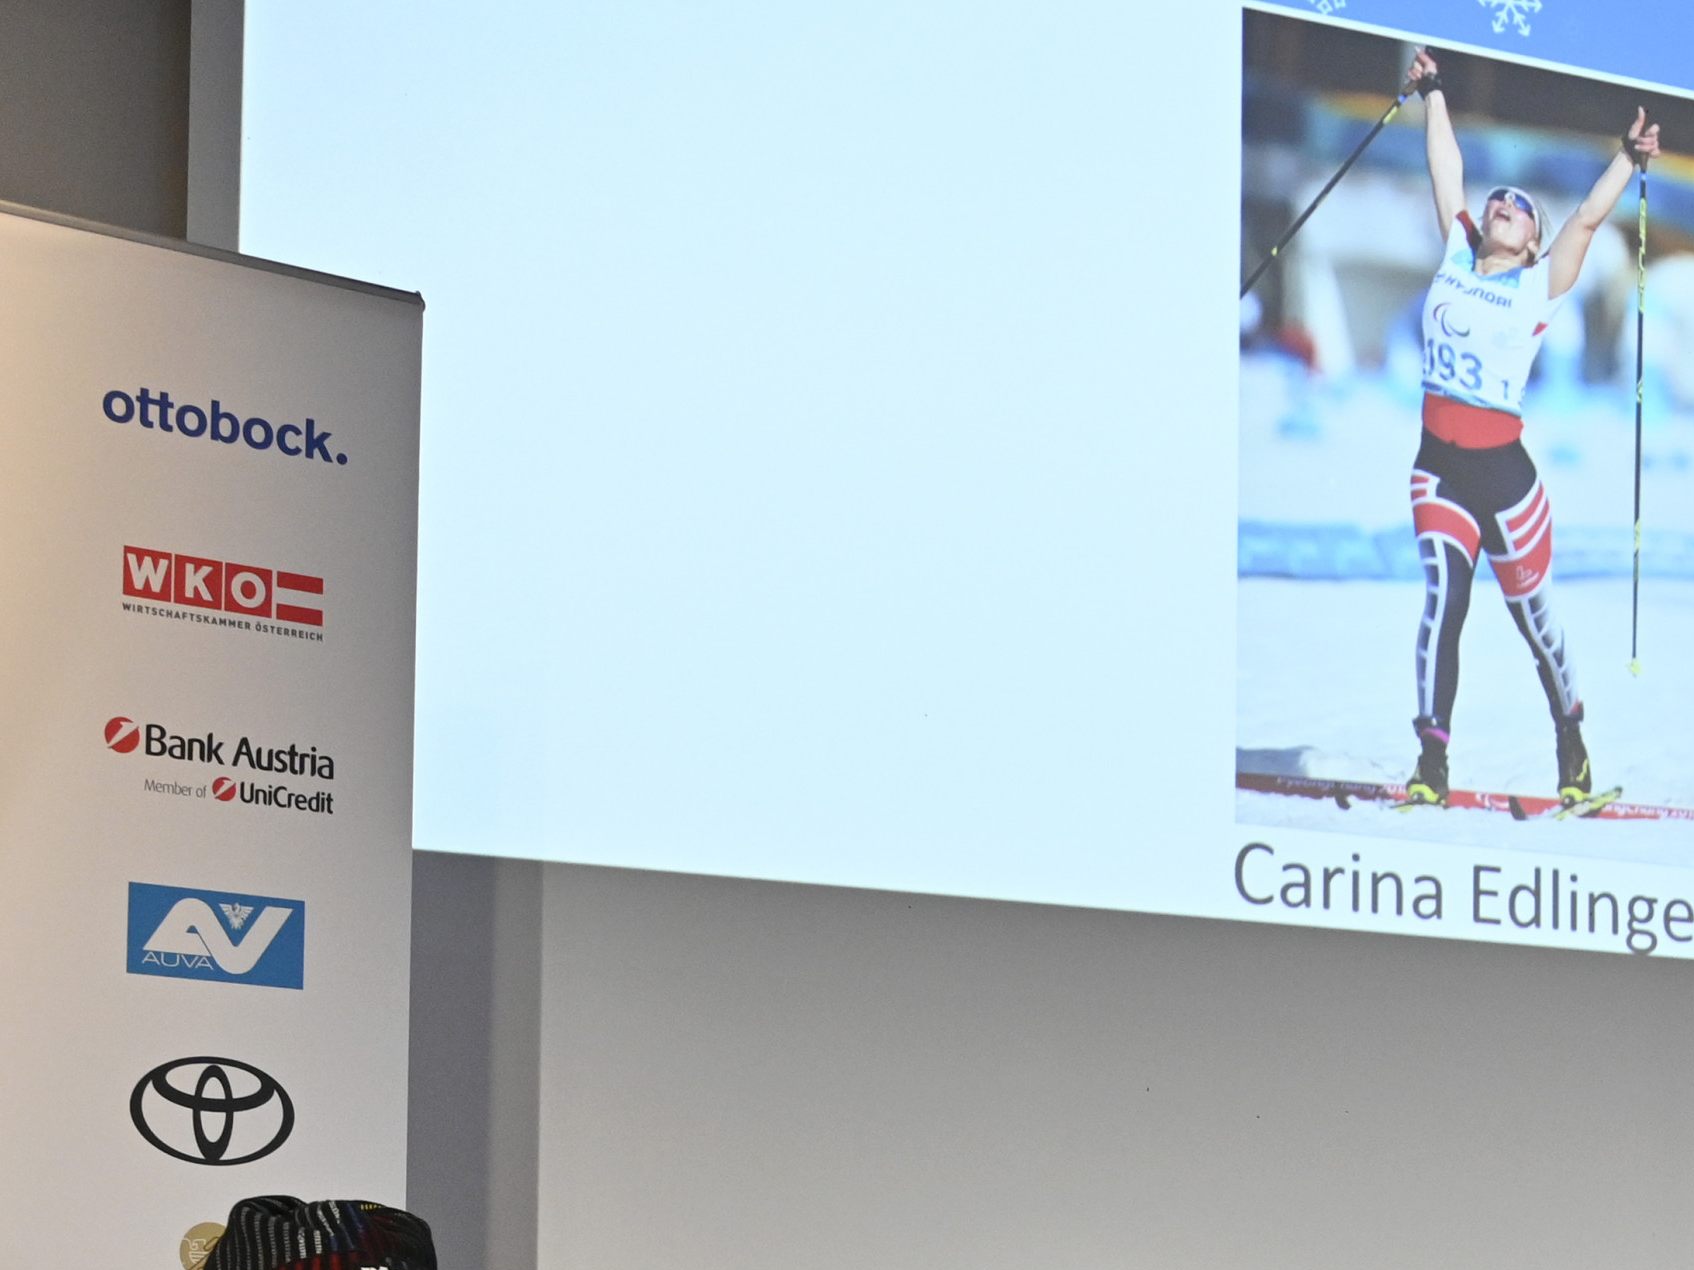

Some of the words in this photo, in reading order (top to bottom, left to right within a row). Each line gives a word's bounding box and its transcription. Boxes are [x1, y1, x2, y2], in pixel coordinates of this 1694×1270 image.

[102, 386, 349, 466] ottobock.
[126, 552, 268, 610] WKO
[121, 602, 252, 631] WIRTSCHAFTSKAMMER
[254, 621, 325, 642] ÖSTERREICH
[144, 723, 225, 766] Bank
[231, 736, 335, 780] Austria
[143, 779, 194, 798] Member
[195, 784, 208, 800] of
[239, 781, 334, 815] UniCredit
[1233, 841, 1443, 921] Carina
[141, 951, 214, 971] AUVA
